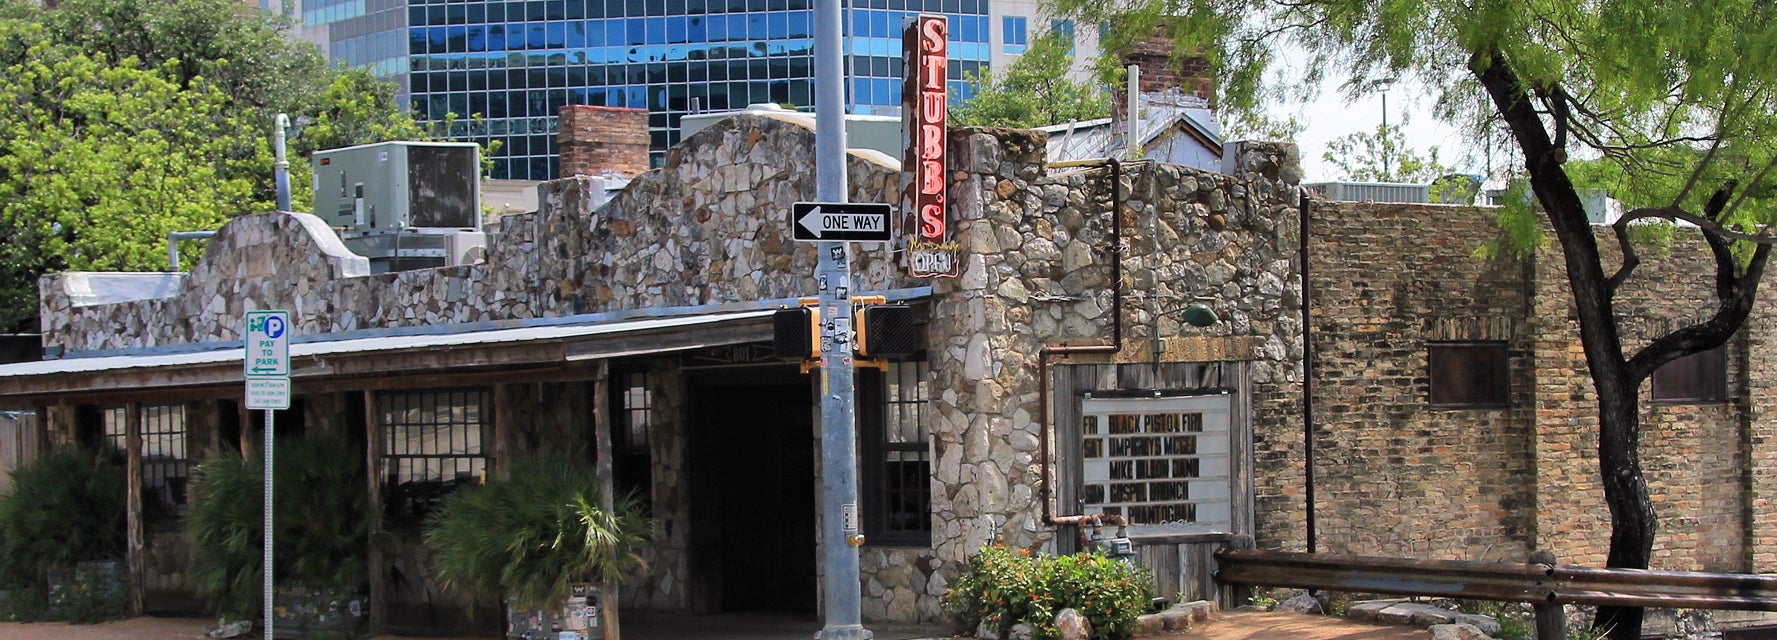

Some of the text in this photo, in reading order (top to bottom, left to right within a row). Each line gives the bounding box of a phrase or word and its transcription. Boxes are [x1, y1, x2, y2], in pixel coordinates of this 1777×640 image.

[922, 19, 946, 238] STUBB'S
[823, 215, 880, 230] ONE WAY
[915, 253, 951, 272] OPEN
[732, 345, 750, 362] 801
[1083, 416, 1098, 434] FRI
[1109, 414, 1141, 434] BLACK
[1144, 413, 1180, 433] PISTOL
[1110, 460, 1133, 480] MIKE
